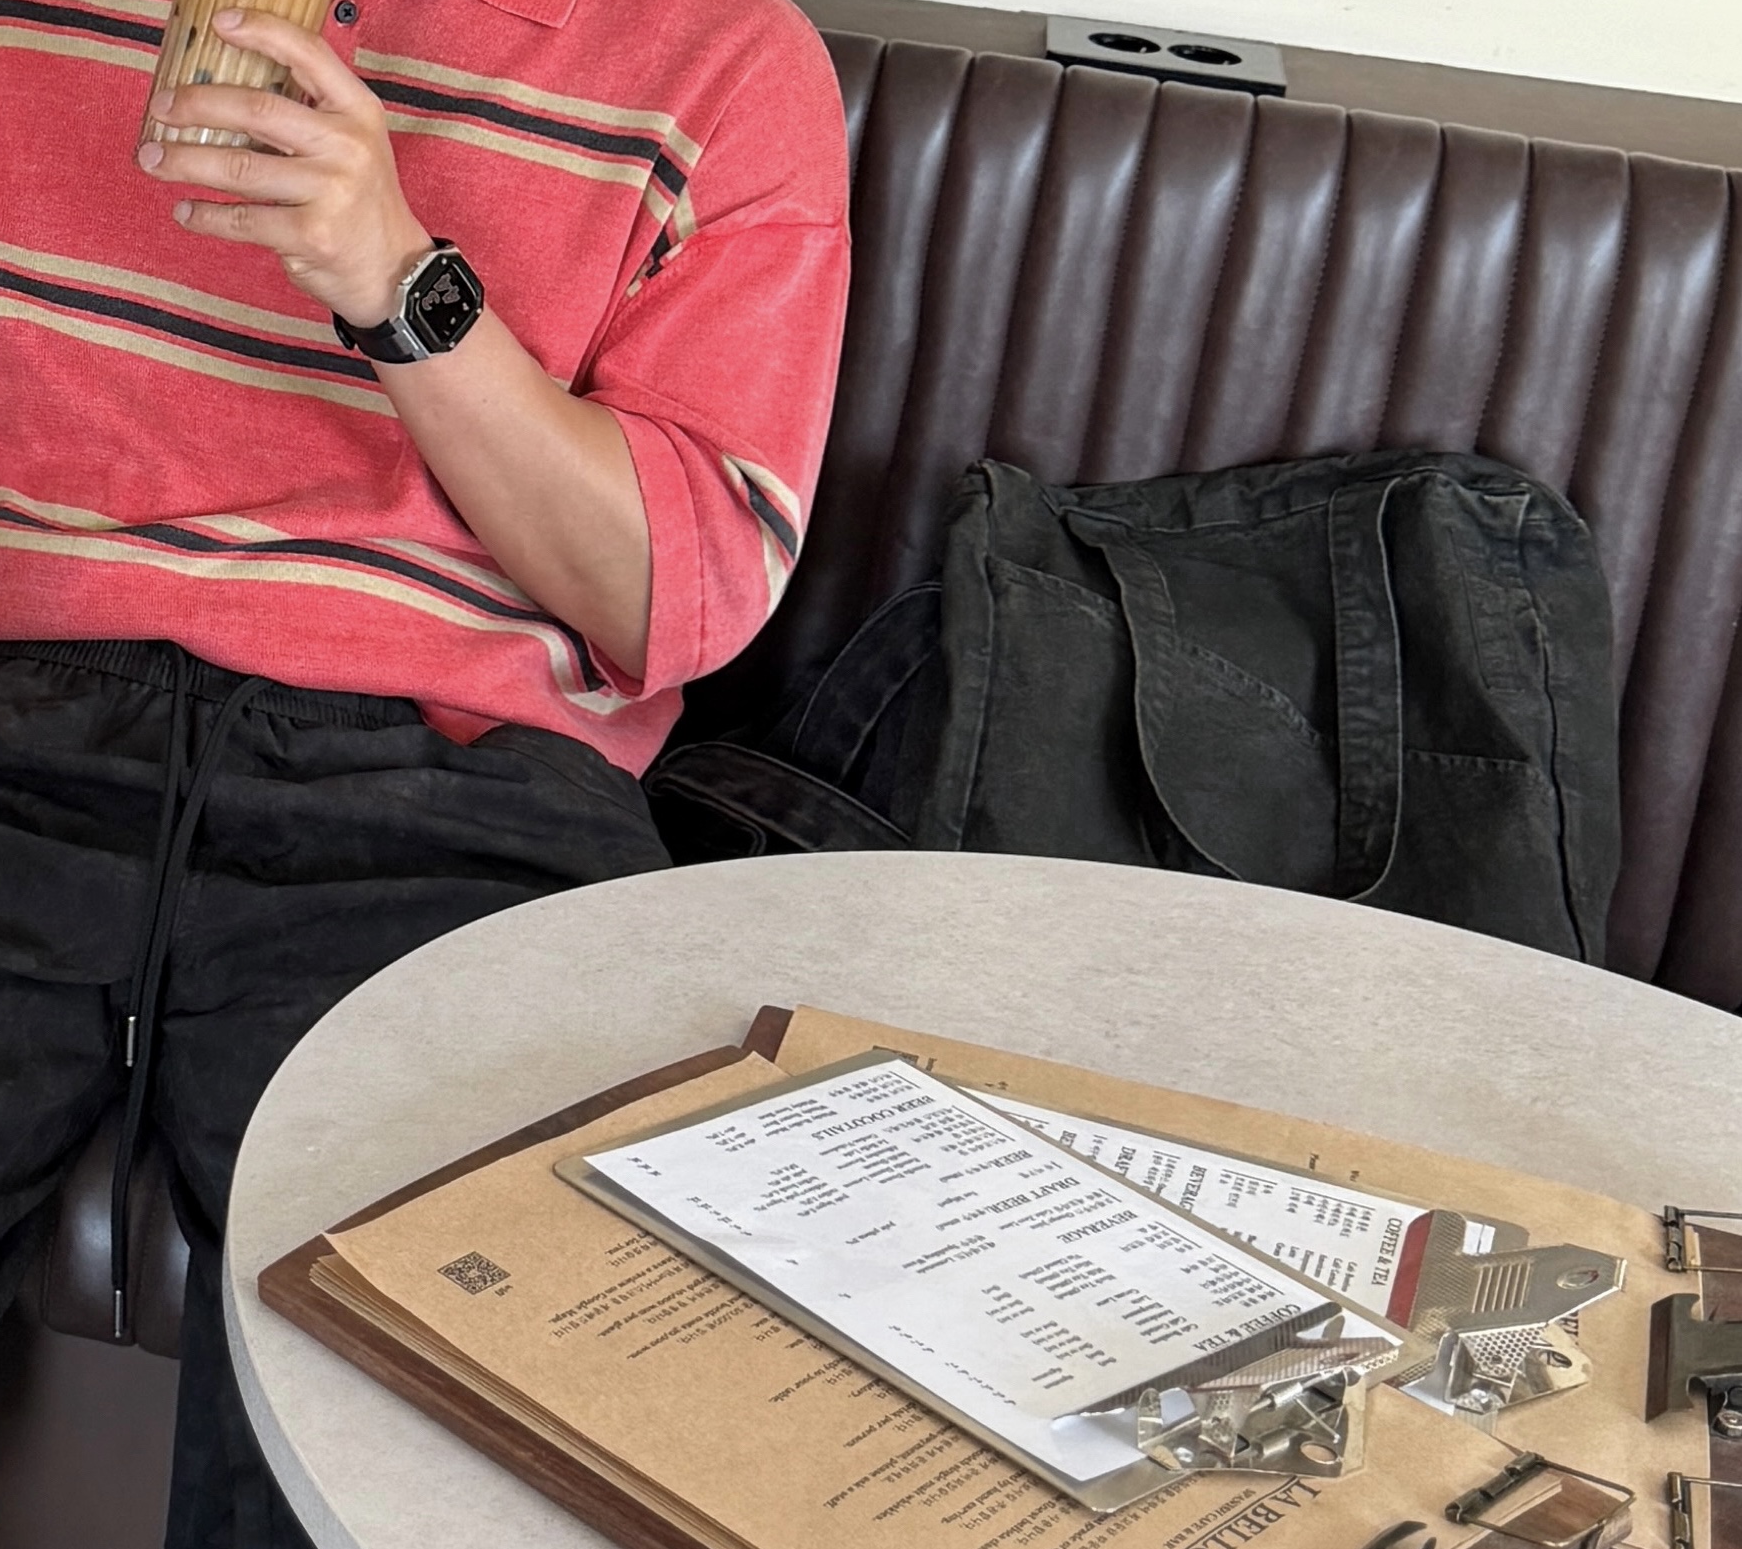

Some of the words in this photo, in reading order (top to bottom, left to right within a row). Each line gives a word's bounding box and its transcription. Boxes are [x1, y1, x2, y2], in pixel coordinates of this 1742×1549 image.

[890, 1095, 937, 1113] BEER
[987, 1149, 1034, 1168] BEER
[1028, 1176, 1081, 1199] DRAFT
[1055, 1209, 1139, 1244] BEVERAGE
[1378, 1216, 1403, 1257] COFFEE
[1370, 1266, 1390, 1287] TEA
[1238, 1303, 1302, 1332] COFFEE
[1223, 1327, 1242, 1337] &
[1191, 1334, 1227, 1352] TEA
[1274, 1480, 1321, 1512] LA
[1189, 1512, 1219, 1531] CAFE
[1162, 1532, 1188, 1549] BAR
